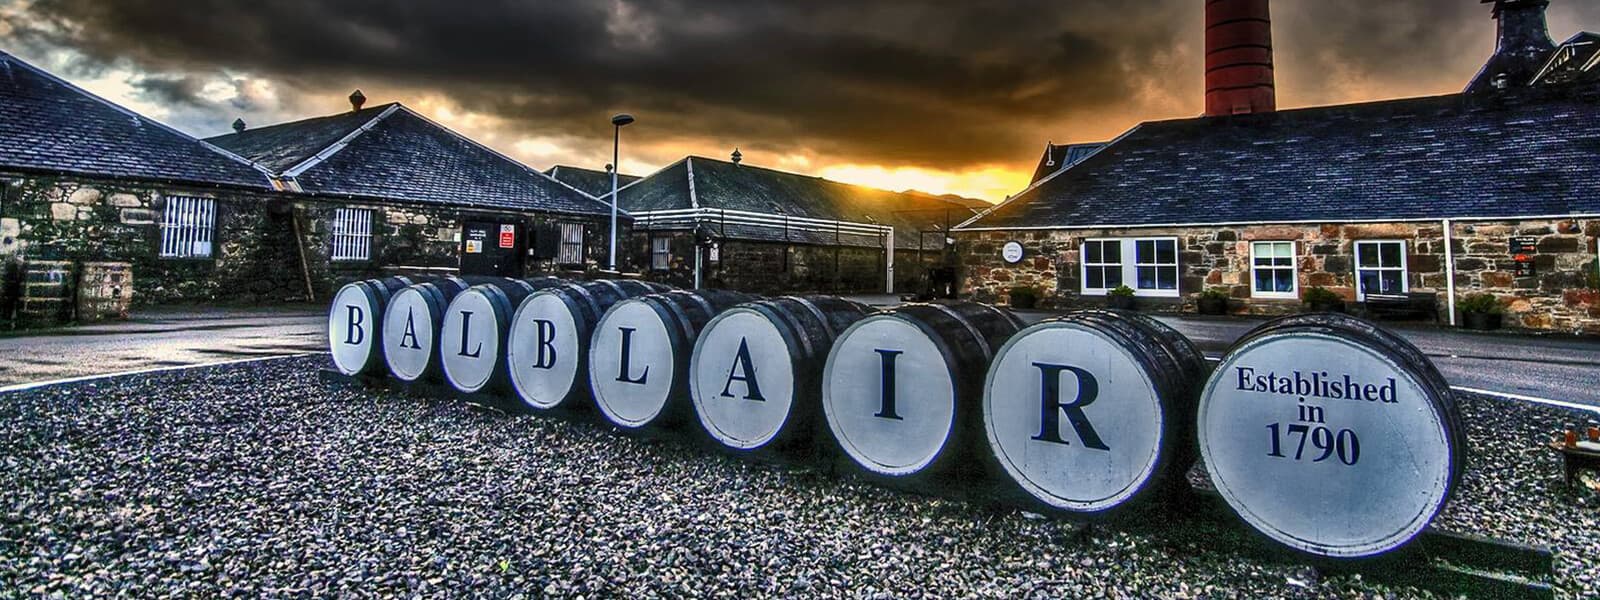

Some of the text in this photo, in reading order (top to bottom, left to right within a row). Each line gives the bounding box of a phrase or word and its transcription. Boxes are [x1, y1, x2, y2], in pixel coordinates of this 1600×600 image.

[344, 305, 1110, 451] B A L B L A I R
[1235, 366, 1398, 403] Established
[1298, 397, 1326, 424] in
[1266, 422, 1361, 466] 1790
